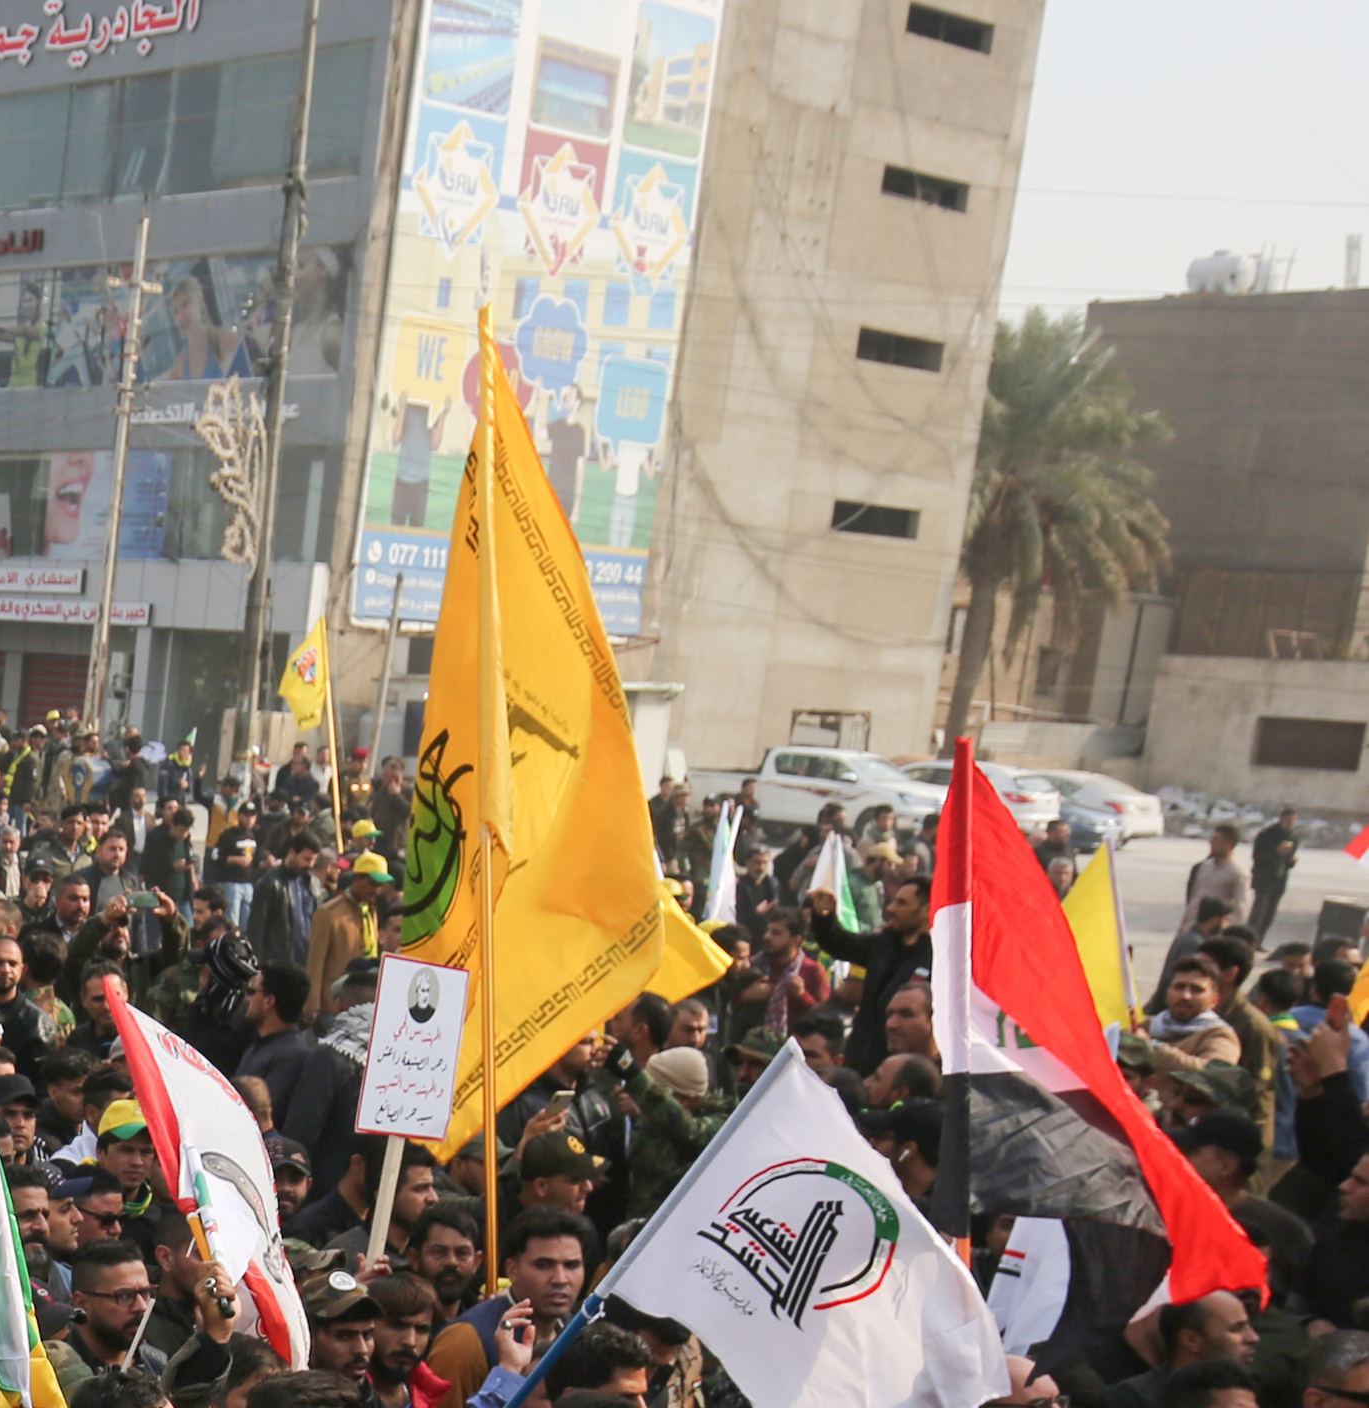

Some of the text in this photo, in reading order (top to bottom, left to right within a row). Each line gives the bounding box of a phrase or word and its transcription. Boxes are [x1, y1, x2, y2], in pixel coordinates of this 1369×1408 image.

[45, 0, 199, 67] الجادرية
[416, 332, 447, 381] WE
[388, 542, 417, 566] 077
[624, 563, 643, 585] 44
